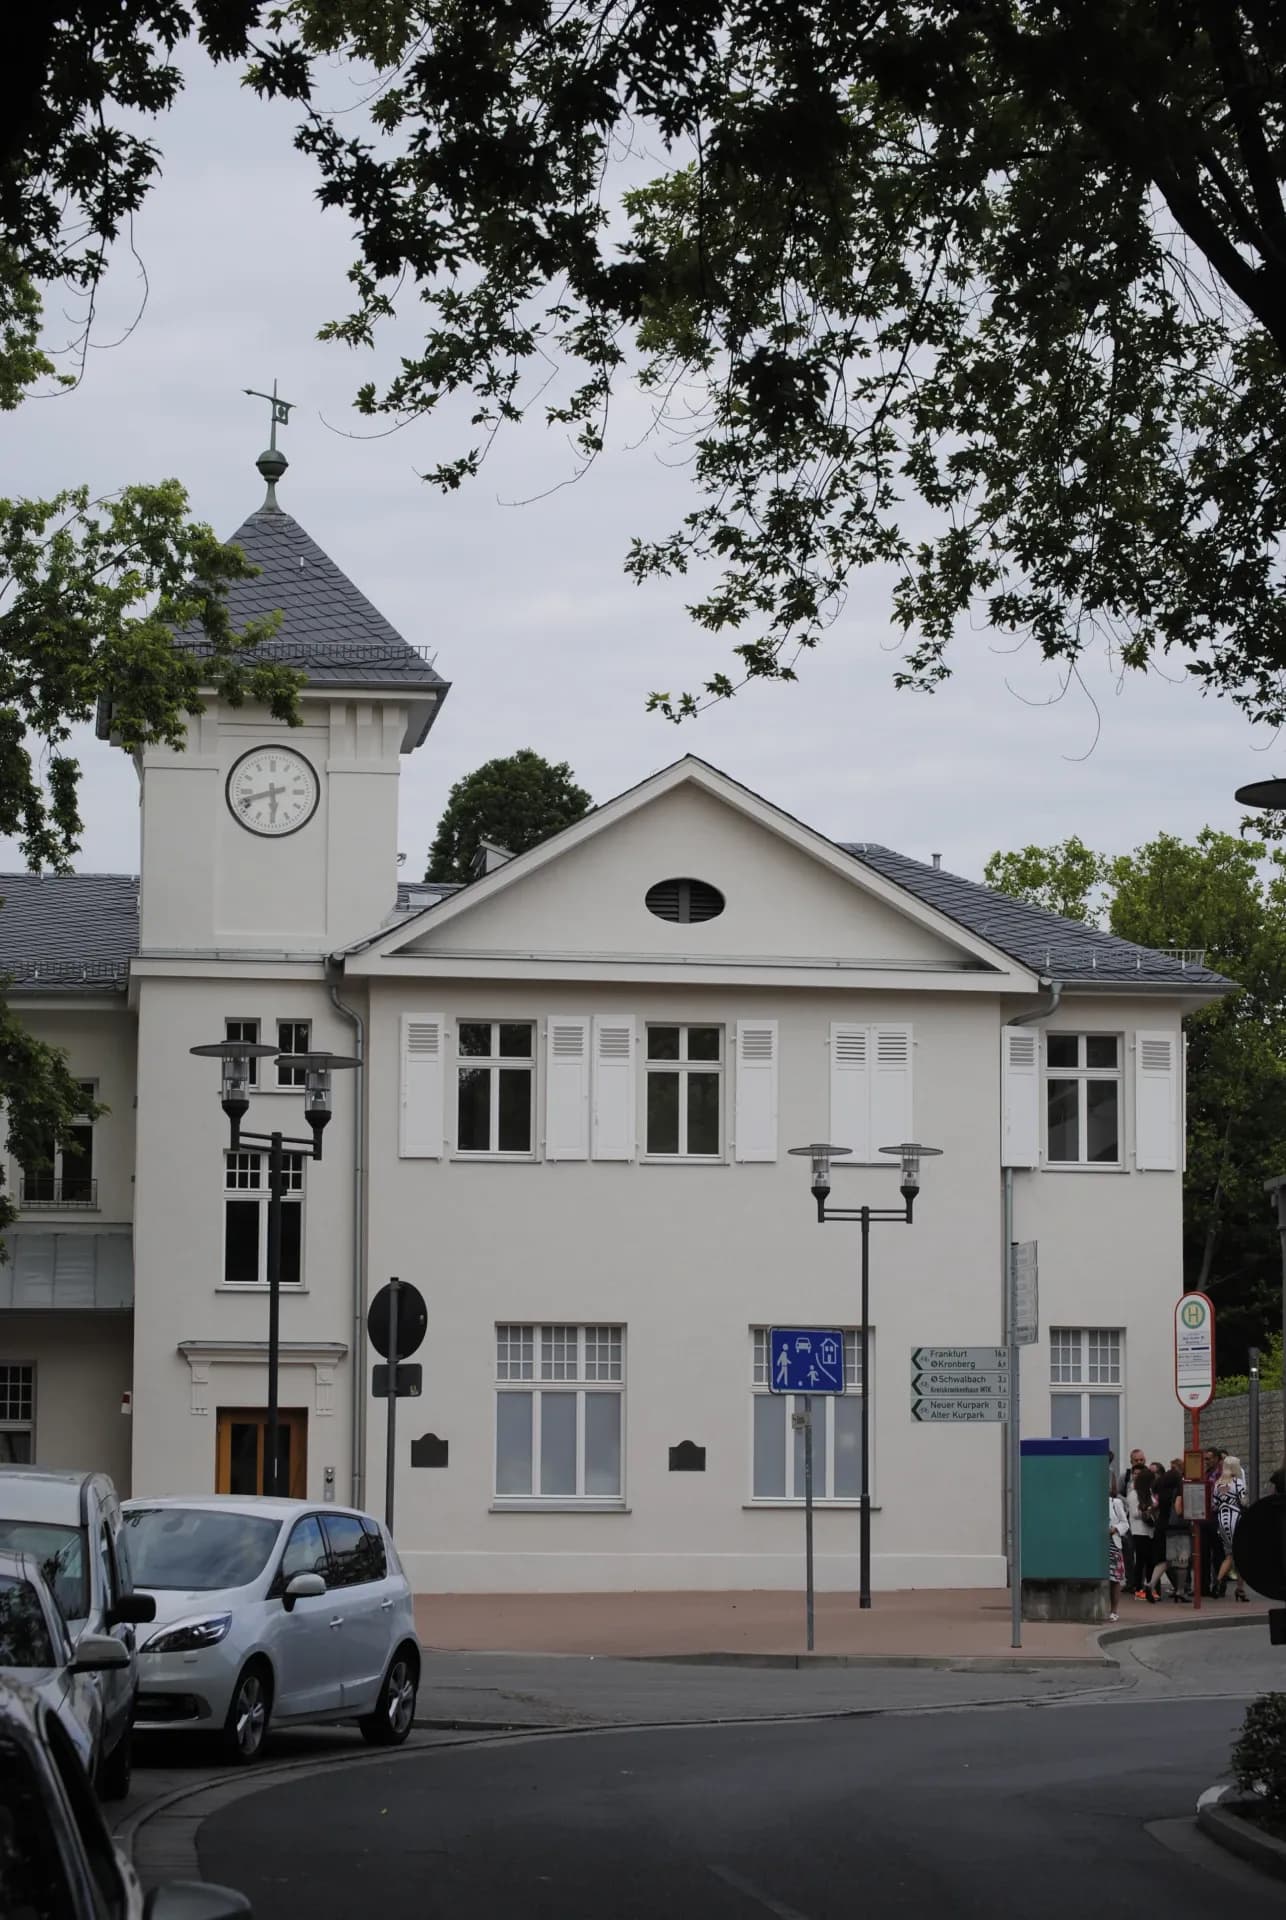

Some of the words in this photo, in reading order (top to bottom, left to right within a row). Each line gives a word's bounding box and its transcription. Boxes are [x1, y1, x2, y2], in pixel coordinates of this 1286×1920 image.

[1187, 1307, 1199, 1323] H
[930, 1350, 967, 1358] Frankfurt
[938, 1360, 976, 1370] Kronberg
[938, 1375, 986, 1383] Schwalbach
[930, 1401, 955, 1409] Neuer
[957, 1401, 989, 1410] Kurpark
[930, 1411, 951, 1419] Alter
[952, 1411, 985, 1421] Kurpark
